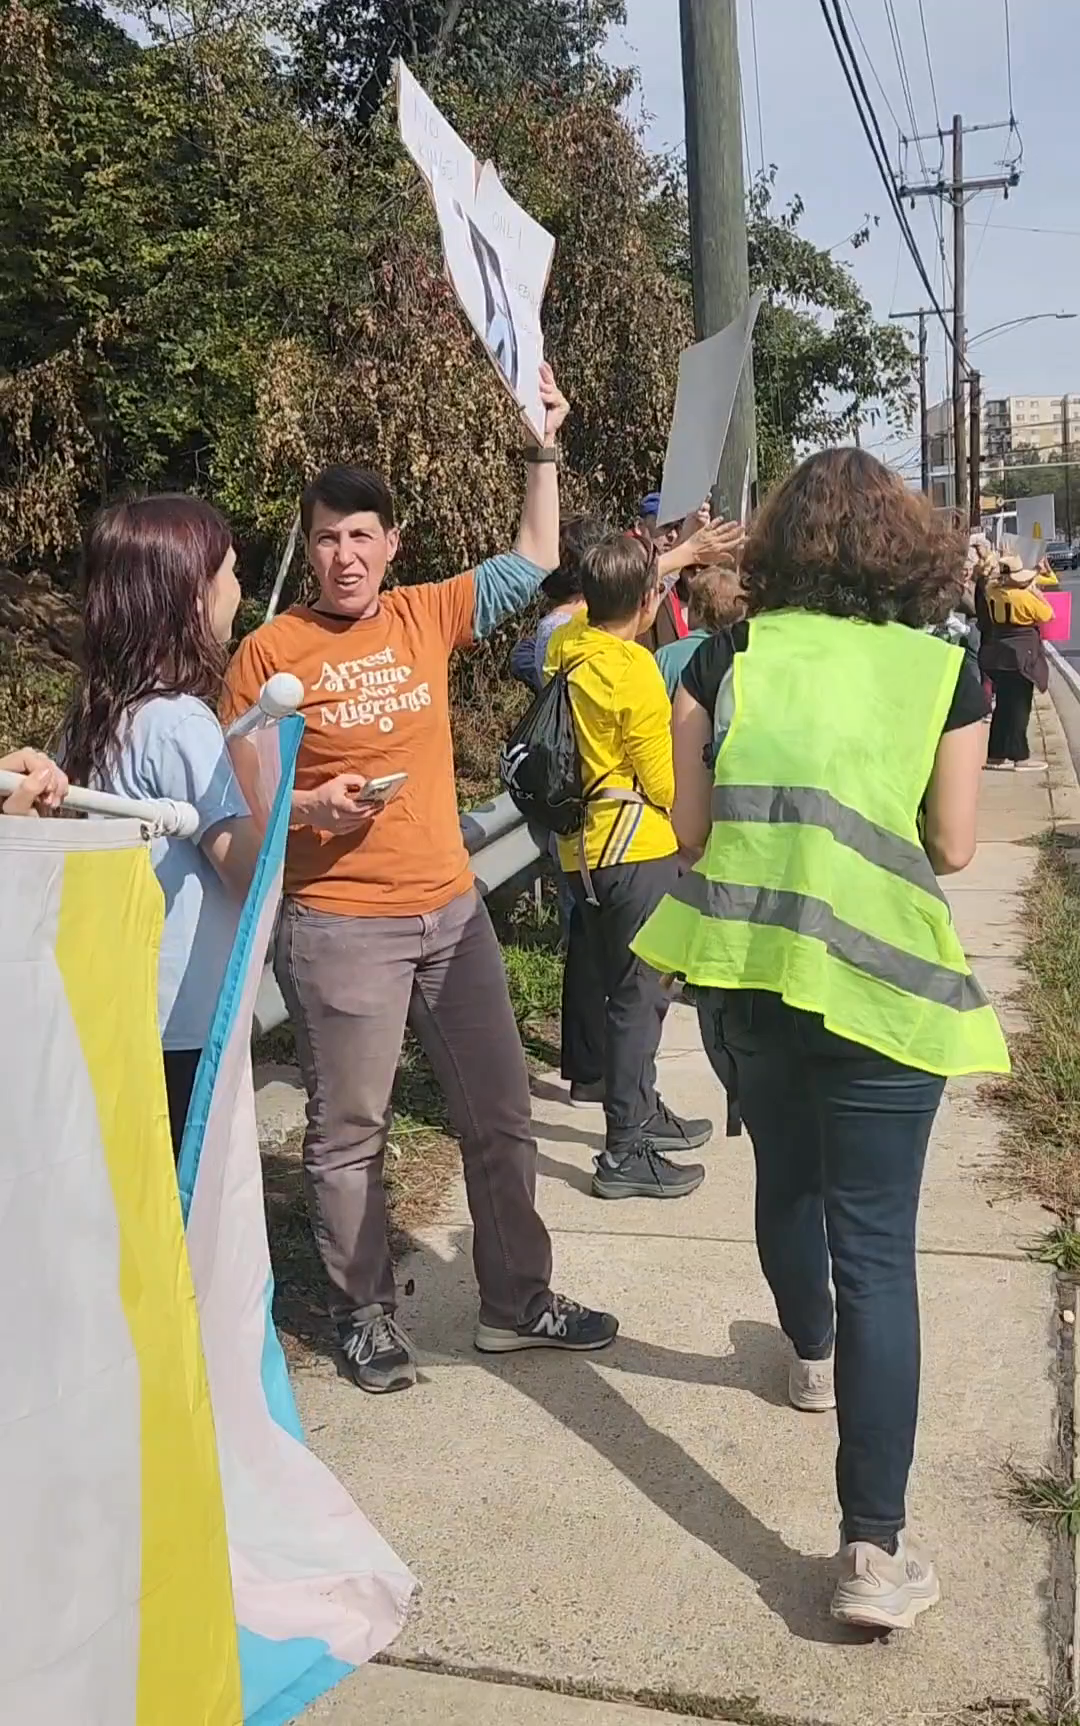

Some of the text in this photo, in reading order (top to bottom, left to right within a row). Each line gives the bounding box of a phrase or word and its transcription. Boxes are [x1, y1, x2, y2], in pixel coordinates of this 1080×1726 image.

[311, 645, 396, 690] Arrest
[320, 682, 432, 728] Migrants
[357, 685, 397, 701] Not
